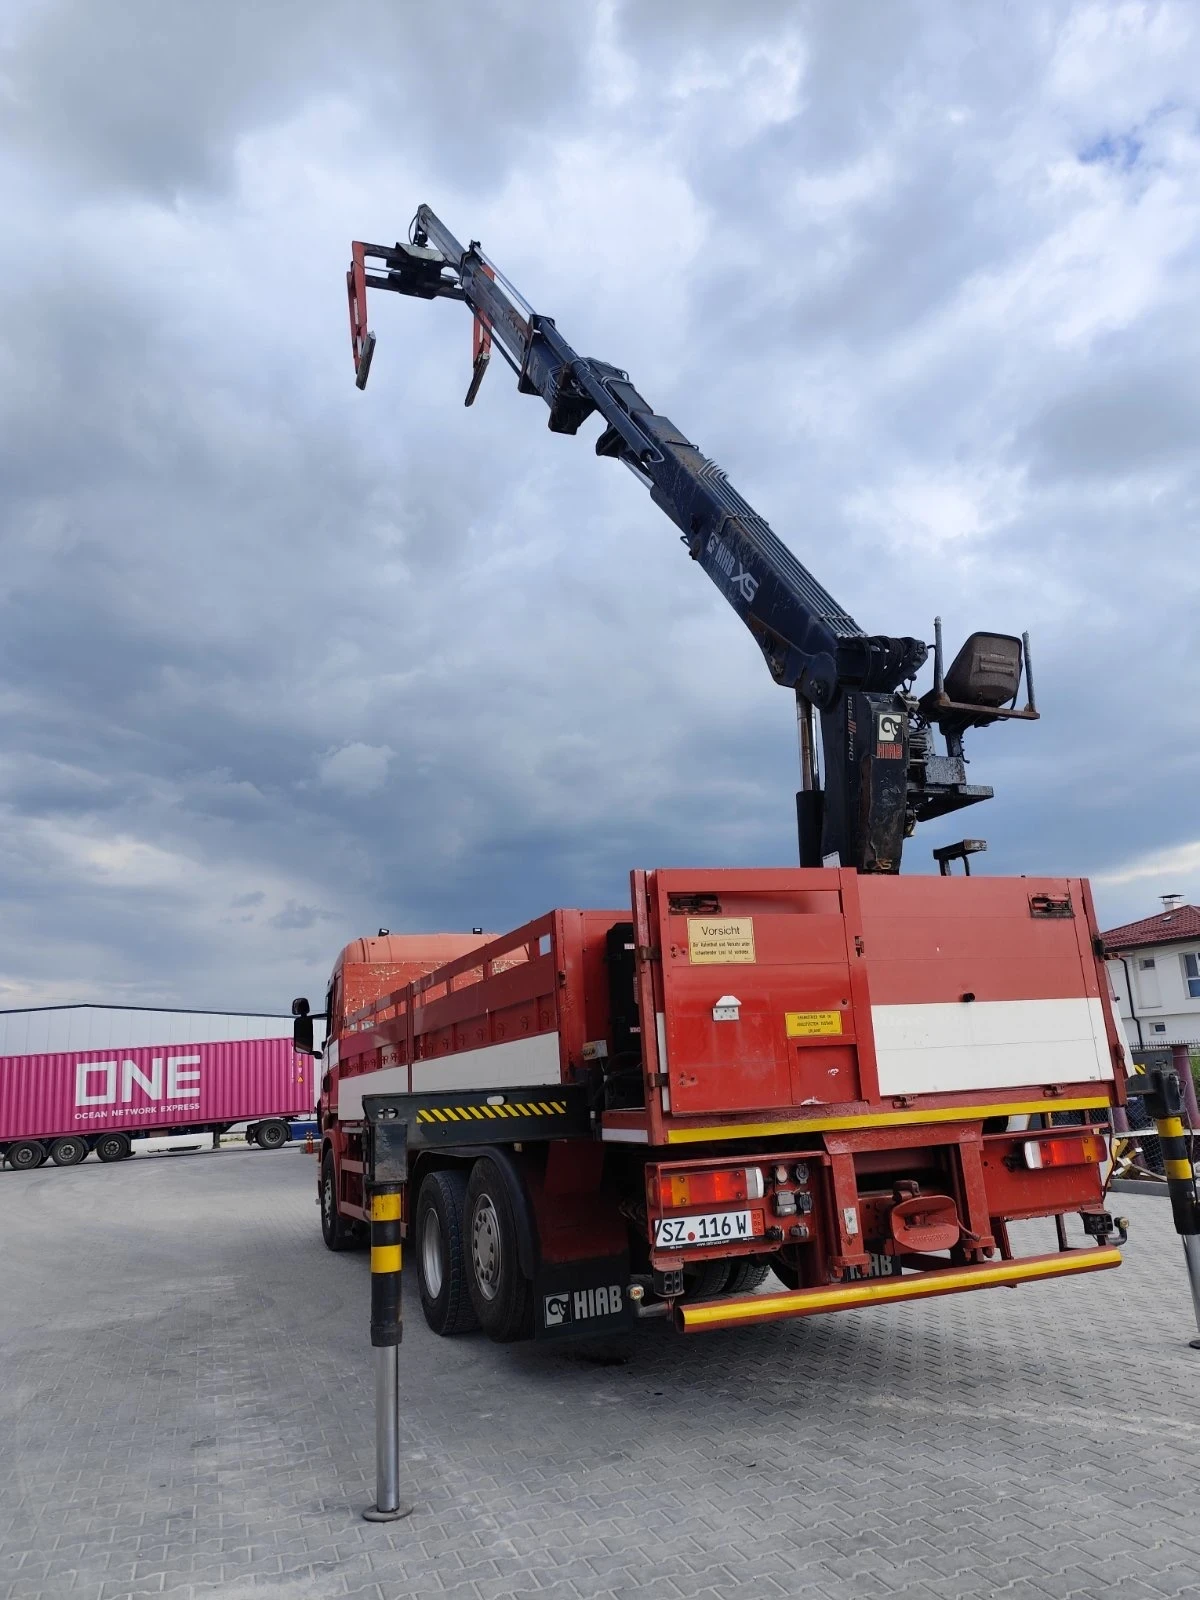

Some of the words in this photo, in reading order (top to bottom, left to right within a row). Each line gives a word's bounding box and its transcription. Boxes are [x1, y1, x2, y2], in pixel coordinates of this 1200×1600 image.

[730, 561, 760, 602] XS
[876, 743, 903, 760] HIAB
[701, 925, 740, 936] Vorsicht
[75, 1055, 201, 1107] ONE
[74, 1110, 108, 1120] OCEAN
[111, 1106, 157, 1117] NETWORK
[160, 1102, 200, 1113] EXPRESS
[662, 1220, 686, 1242] SZ
[699, 1216, 732, 1239] 116
[736, 1214, 747, 1235] W
[573, 1285, 623, 1320] HIAB
